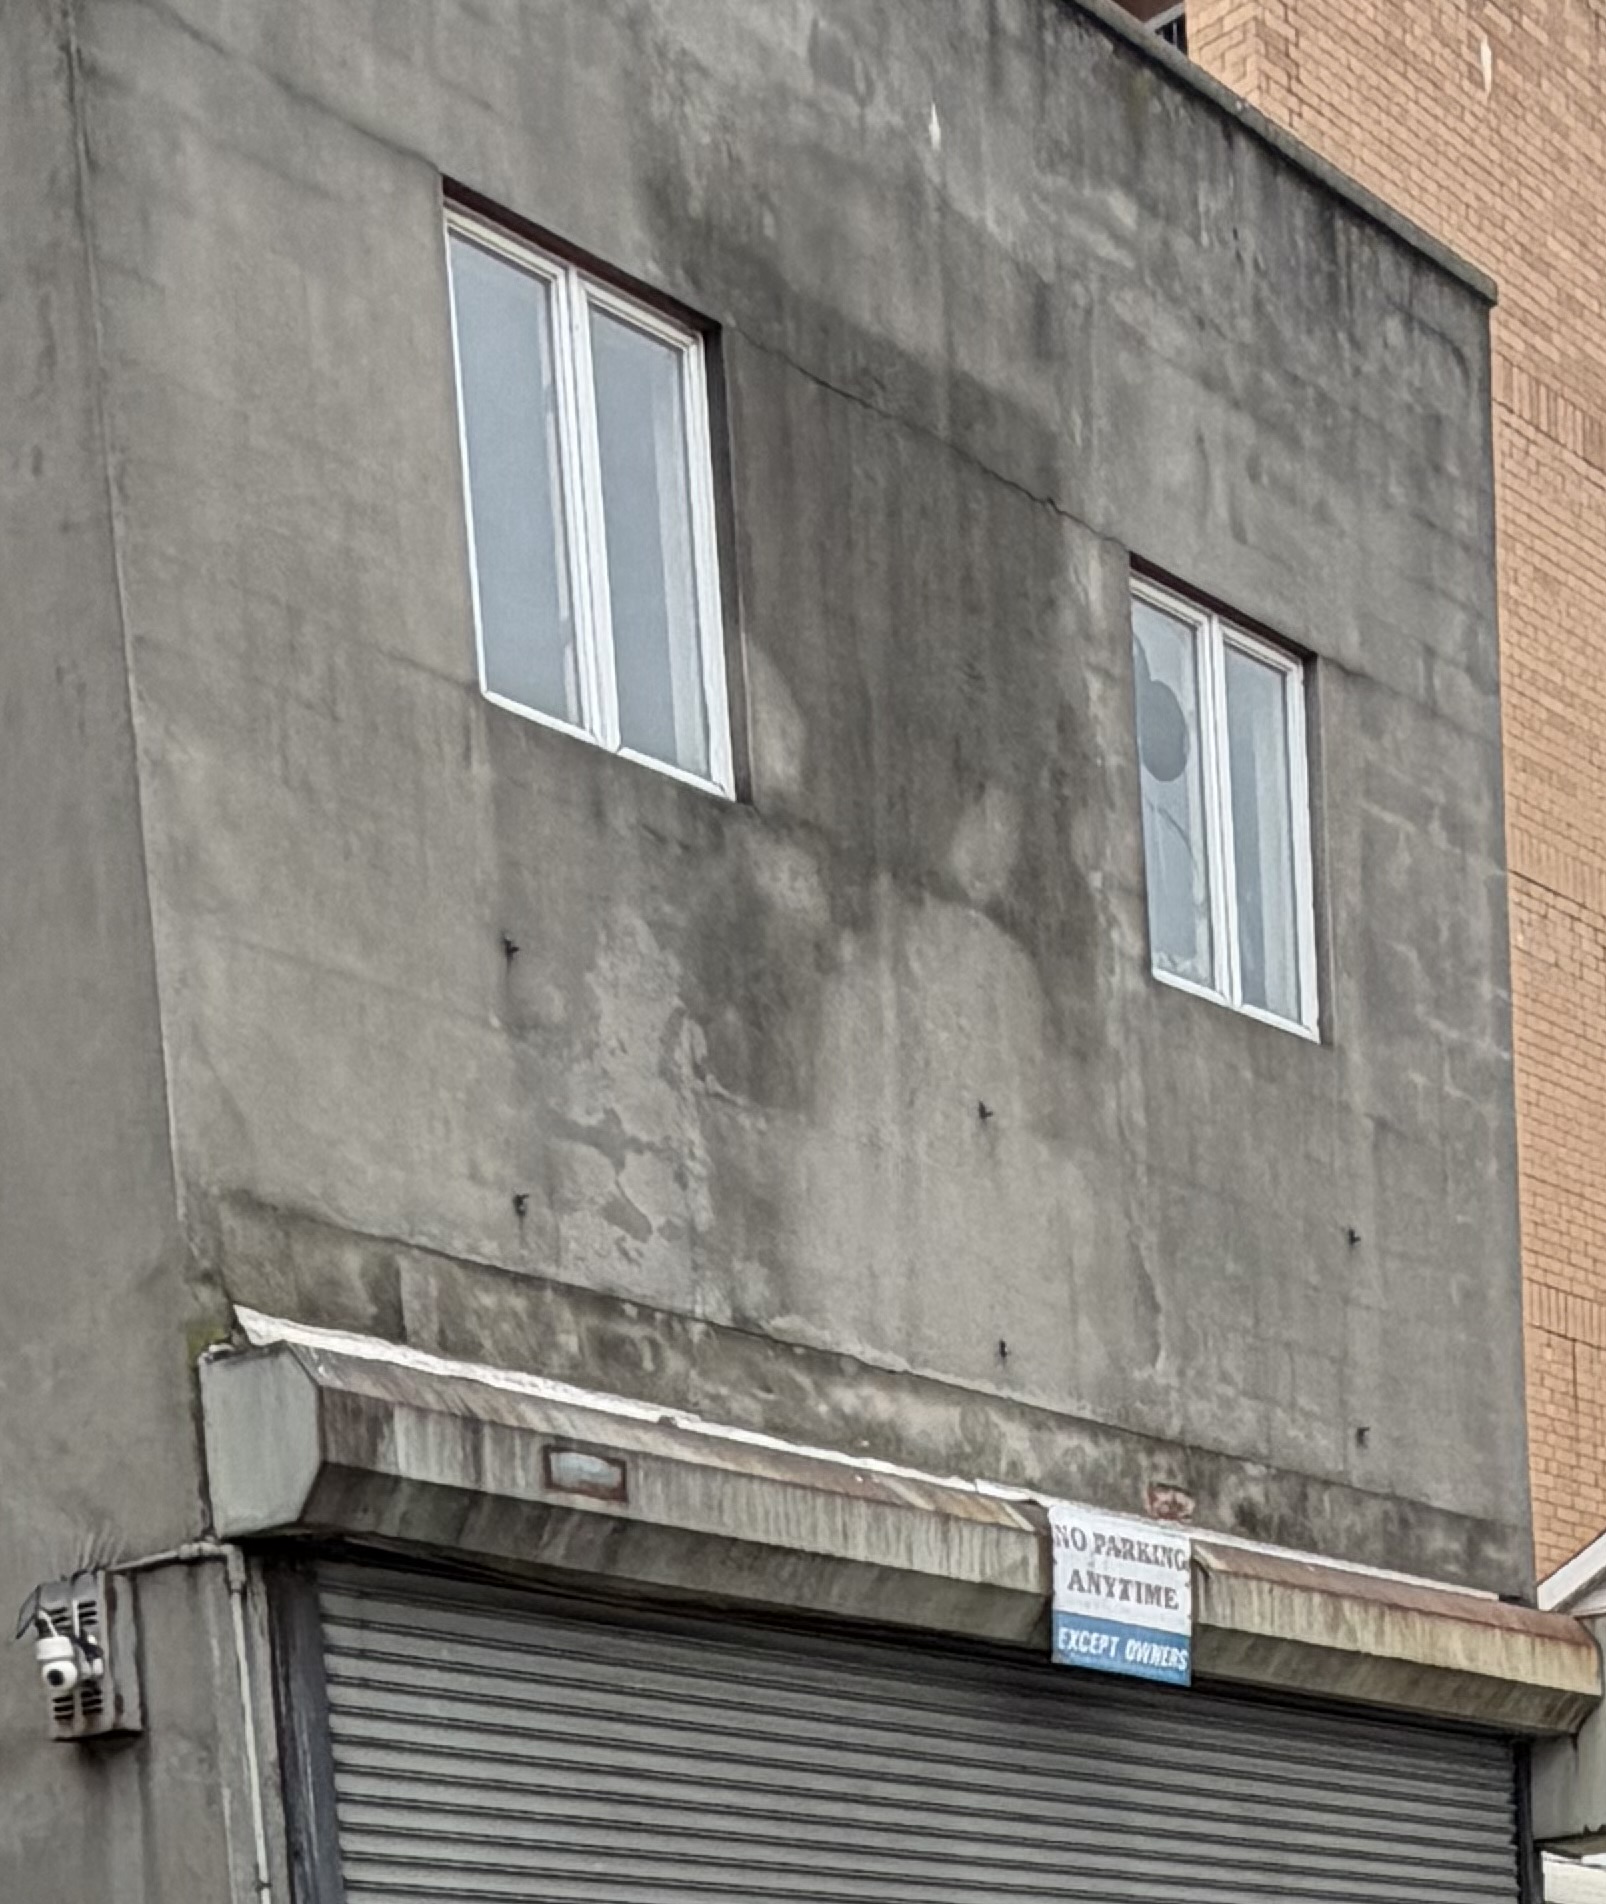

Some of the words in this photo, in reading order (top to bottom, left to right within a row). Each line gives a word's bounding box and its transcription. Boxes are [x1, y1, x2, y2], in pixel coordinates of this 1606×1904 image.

[1054, 1523, 1088, 1551] NO
[1093, 1531, 1188, 1571] PARKING
[1067, 1568, 1179, 1610] ANYTIME
[1058, 1626, 1118, 1658] EXCEPT
[1125, 1638, 1189, 1671] OWNERS
